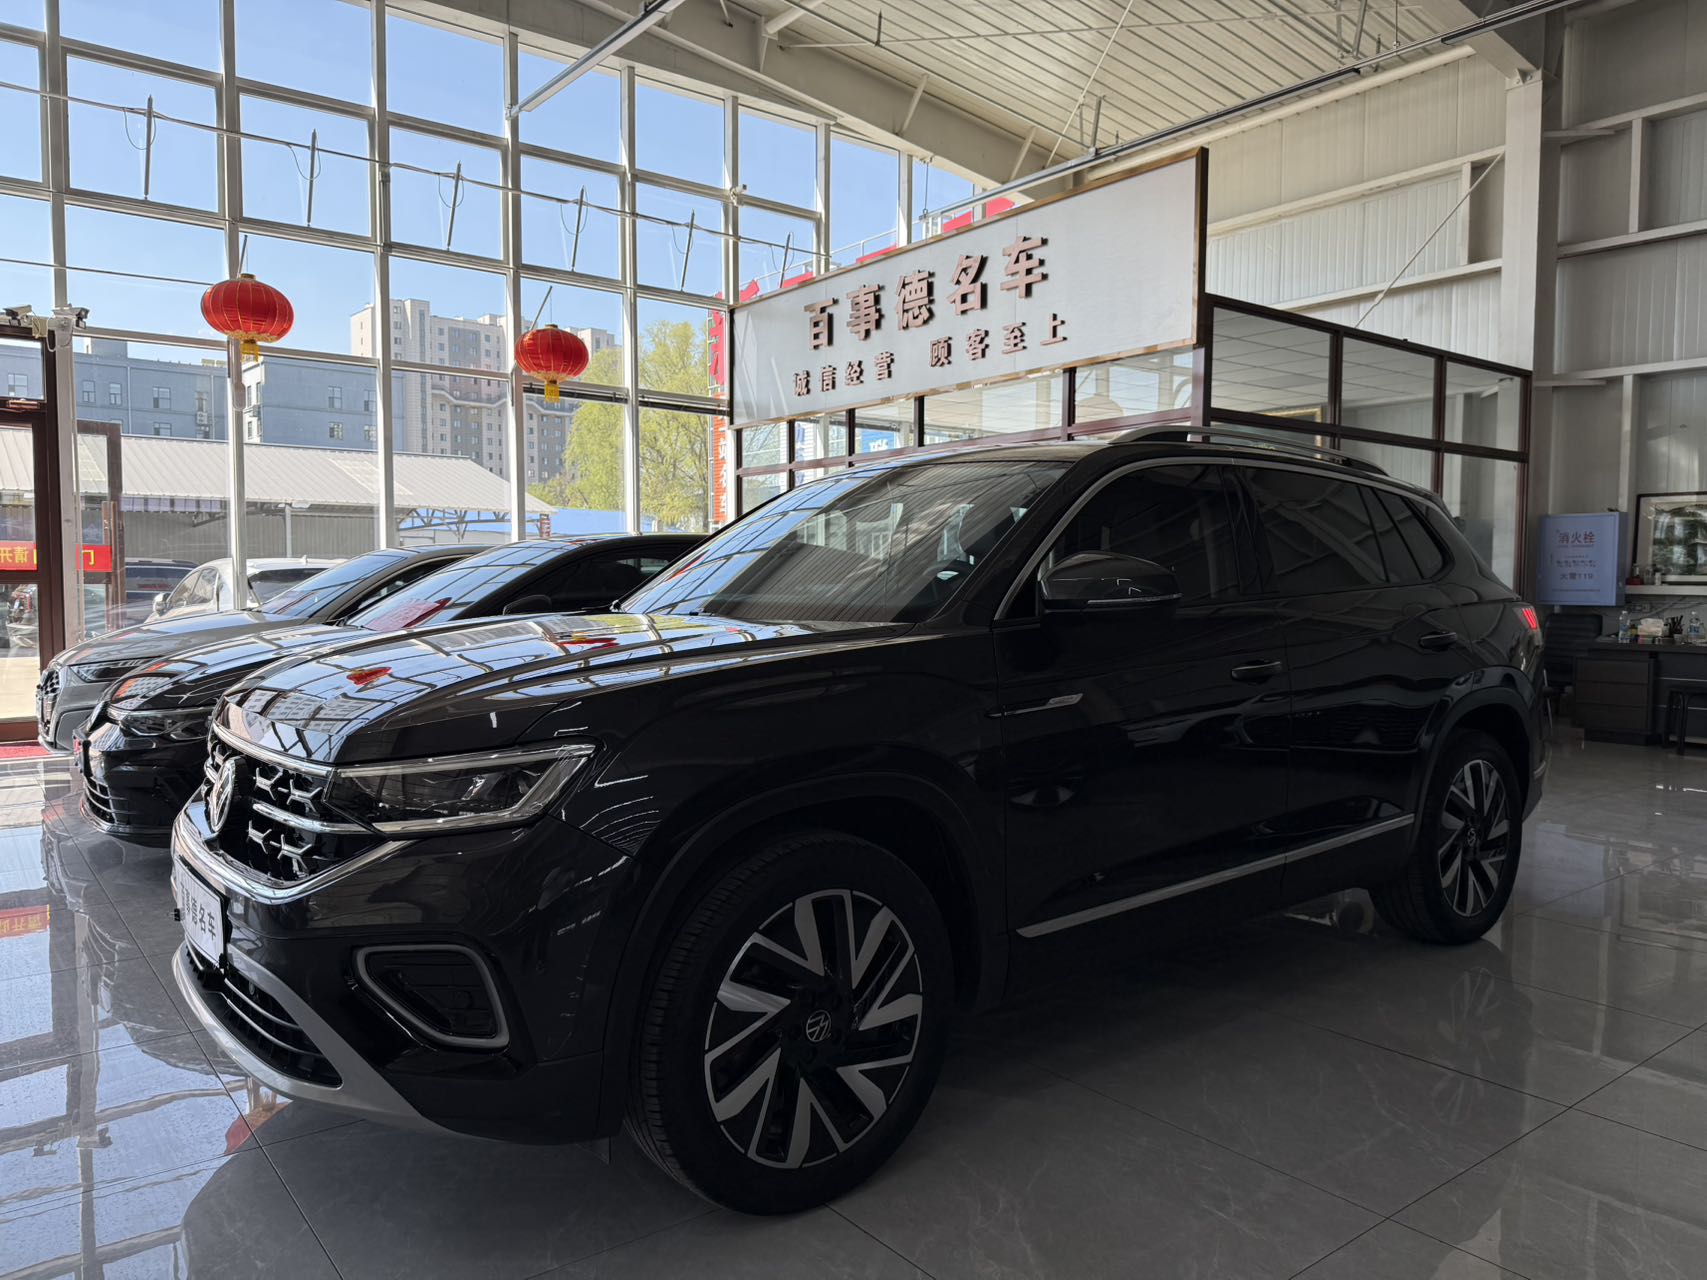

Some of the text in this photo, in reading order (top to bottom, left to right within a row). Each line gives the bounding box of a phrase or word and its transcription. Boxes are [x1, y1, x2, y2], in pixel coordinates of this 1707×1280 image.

[803, 236, 1048, 351] 百事德名车
[793, 313, 1068, 396] 诚信经营 顾客至上
[1557, 531, 1595, 544] 消火栓
